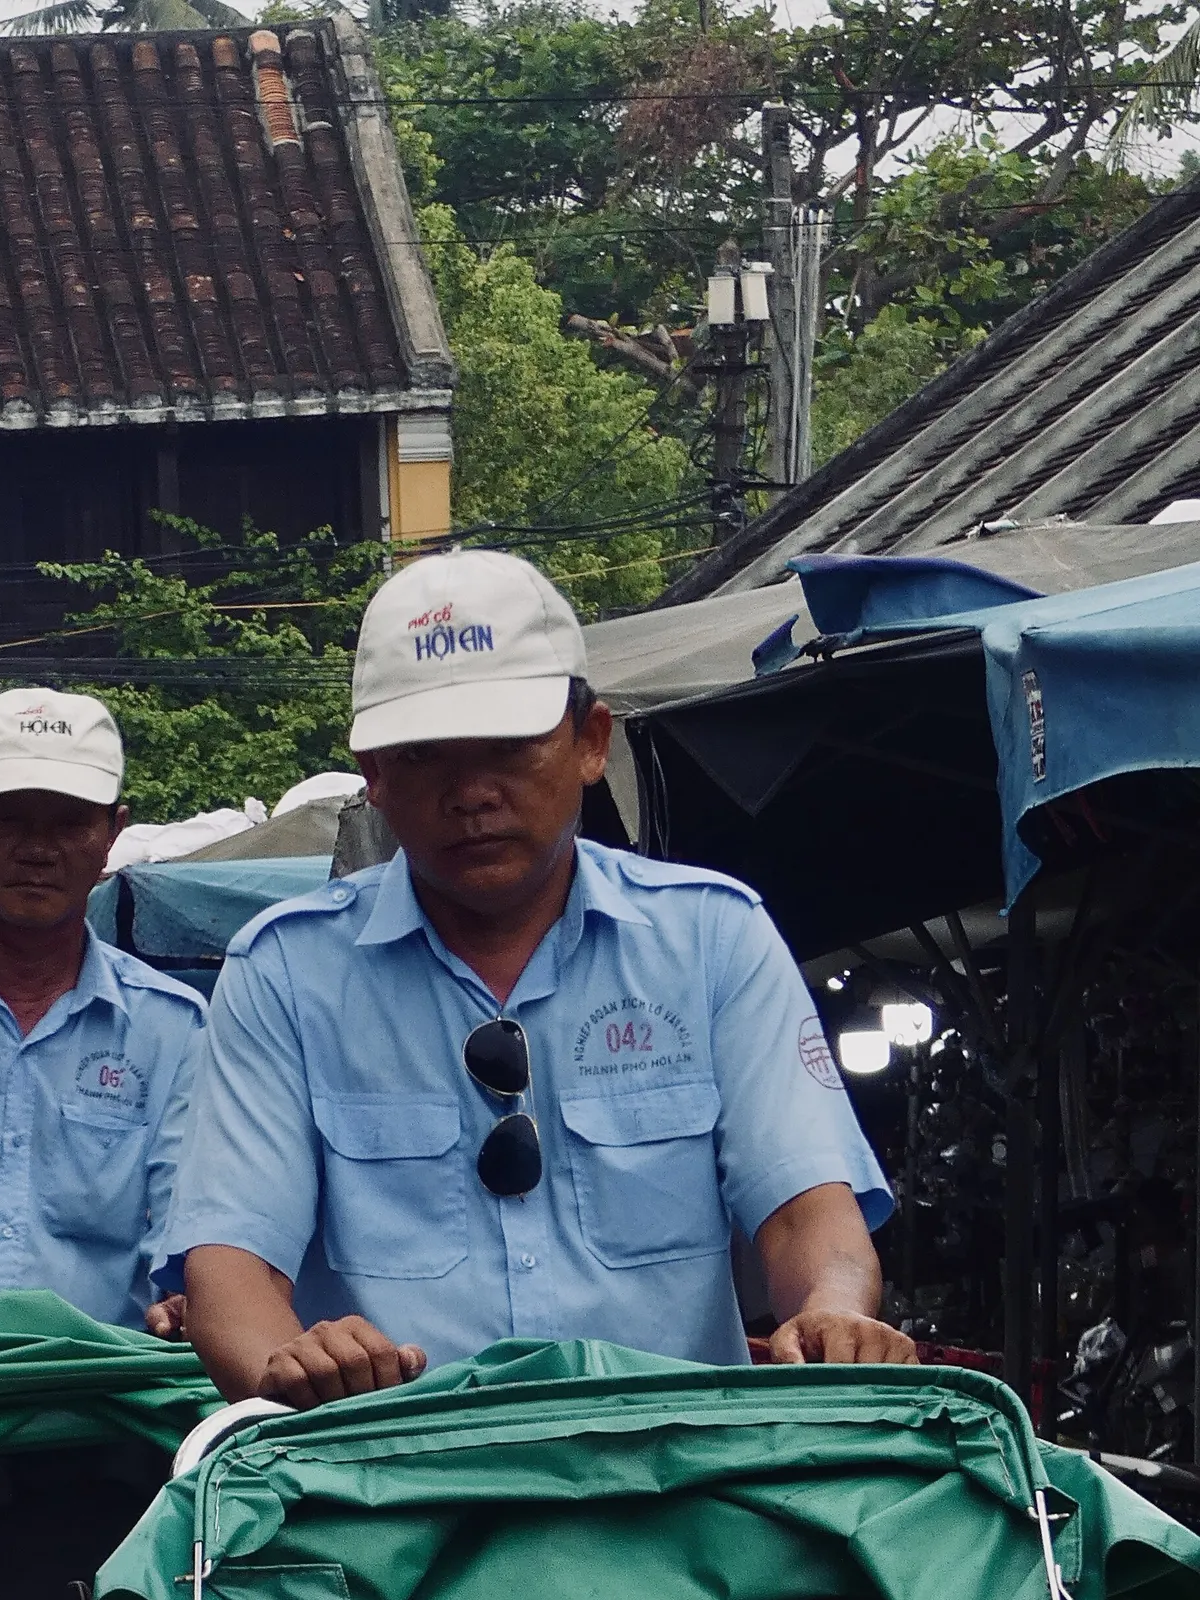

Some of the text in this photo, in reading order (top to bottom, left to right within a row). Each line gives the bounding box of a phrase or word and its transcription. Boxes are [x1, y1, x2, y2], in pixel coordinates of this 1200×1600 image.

[407, 610, 433, 631] PHỐ
[415, 624, 456, 661] HỘI
[606, 1021, 653, 1053] 042
